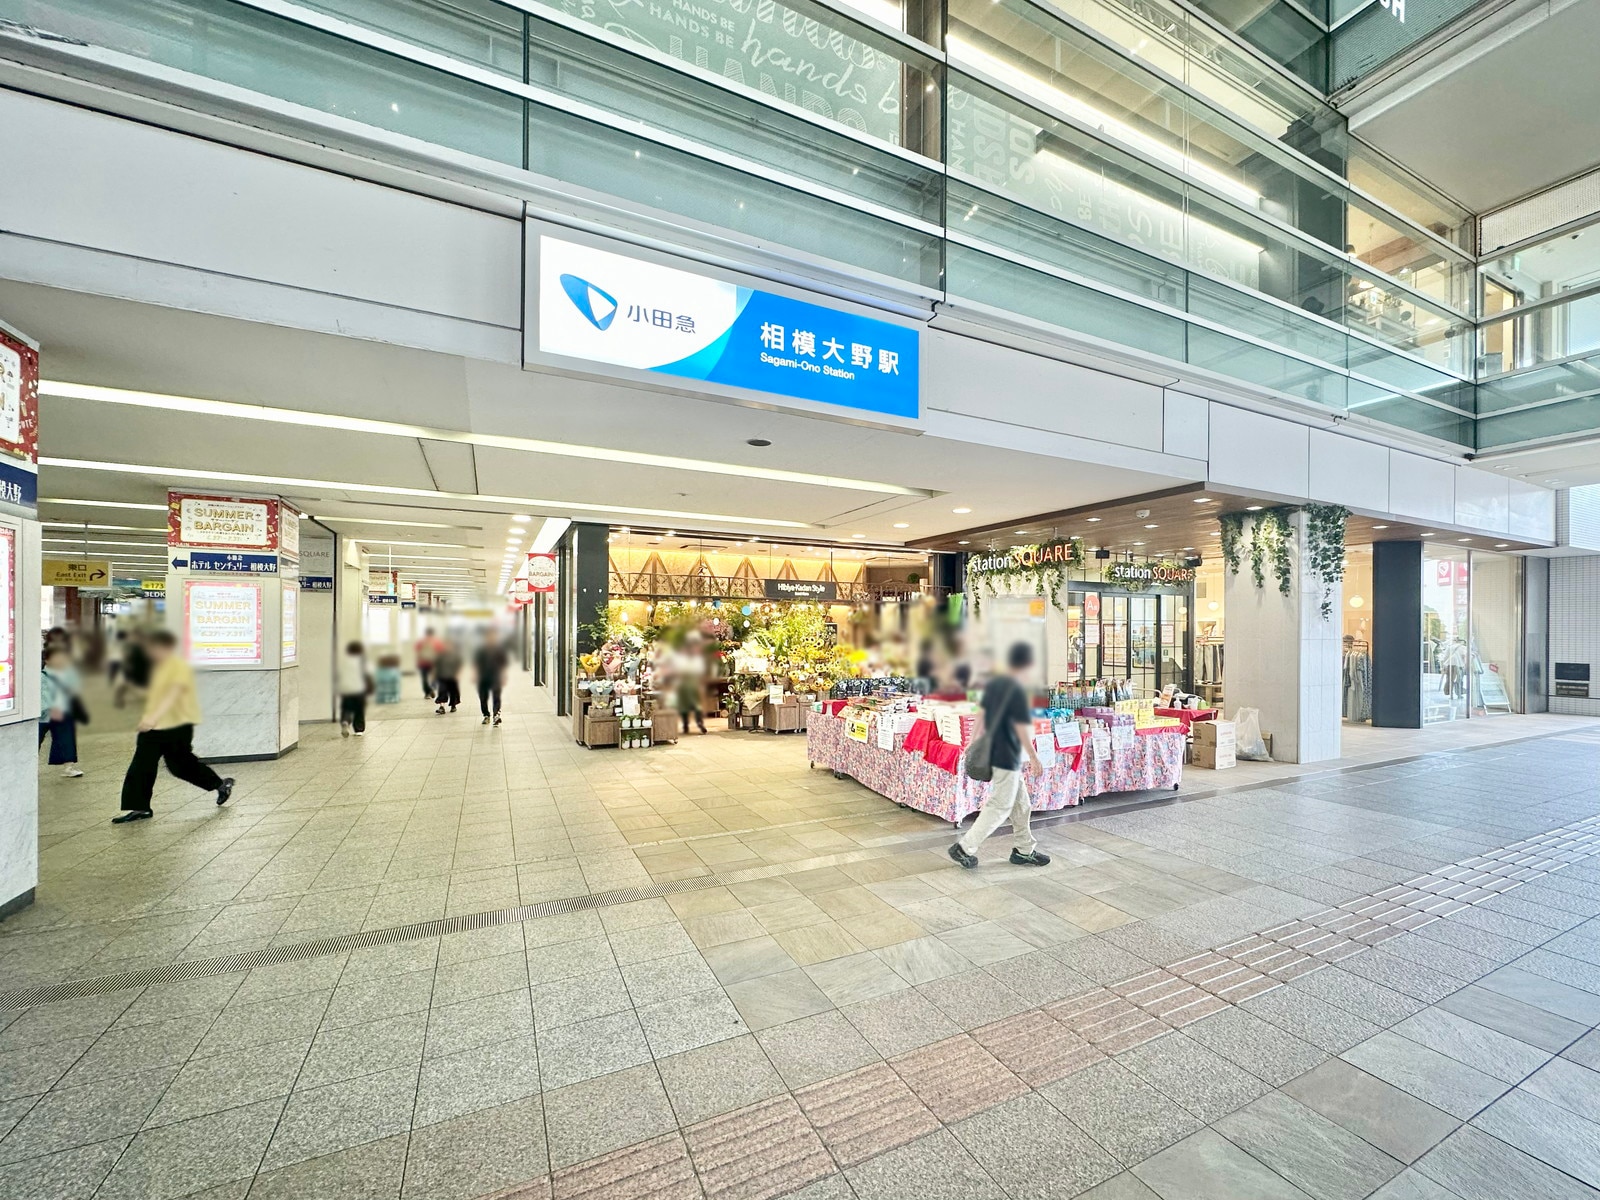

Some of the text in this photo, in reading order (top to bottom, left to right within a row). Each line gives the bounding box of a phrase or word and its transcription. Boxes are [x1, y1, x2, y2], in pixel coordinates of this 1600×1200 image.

[650, 5, 734, 48] HANDS BE
[720, 17, 735, 32] BE
[741, 18, 868, 104] hands
[627, 305, 696, 334] 小田急
[760, 321, 899, 376] 相模大野駅
[760, 351, 855, 380] Sagami-Ono Station
[194, 507, 254, 520] SUMMER
[194, 521, 254, 533] BARGAIN
[971, 543, 1074, 572] station SQUARE
[191, 561, 211, 571] ホテル
[214, 562, 248, 571] センチュリー
[1114, 565, 1151, 579] station
[812, 584, 826, 594] Style
[195, 600, 251, 610] SUMMER
[196, 615, 250, 624] BARGAIN
